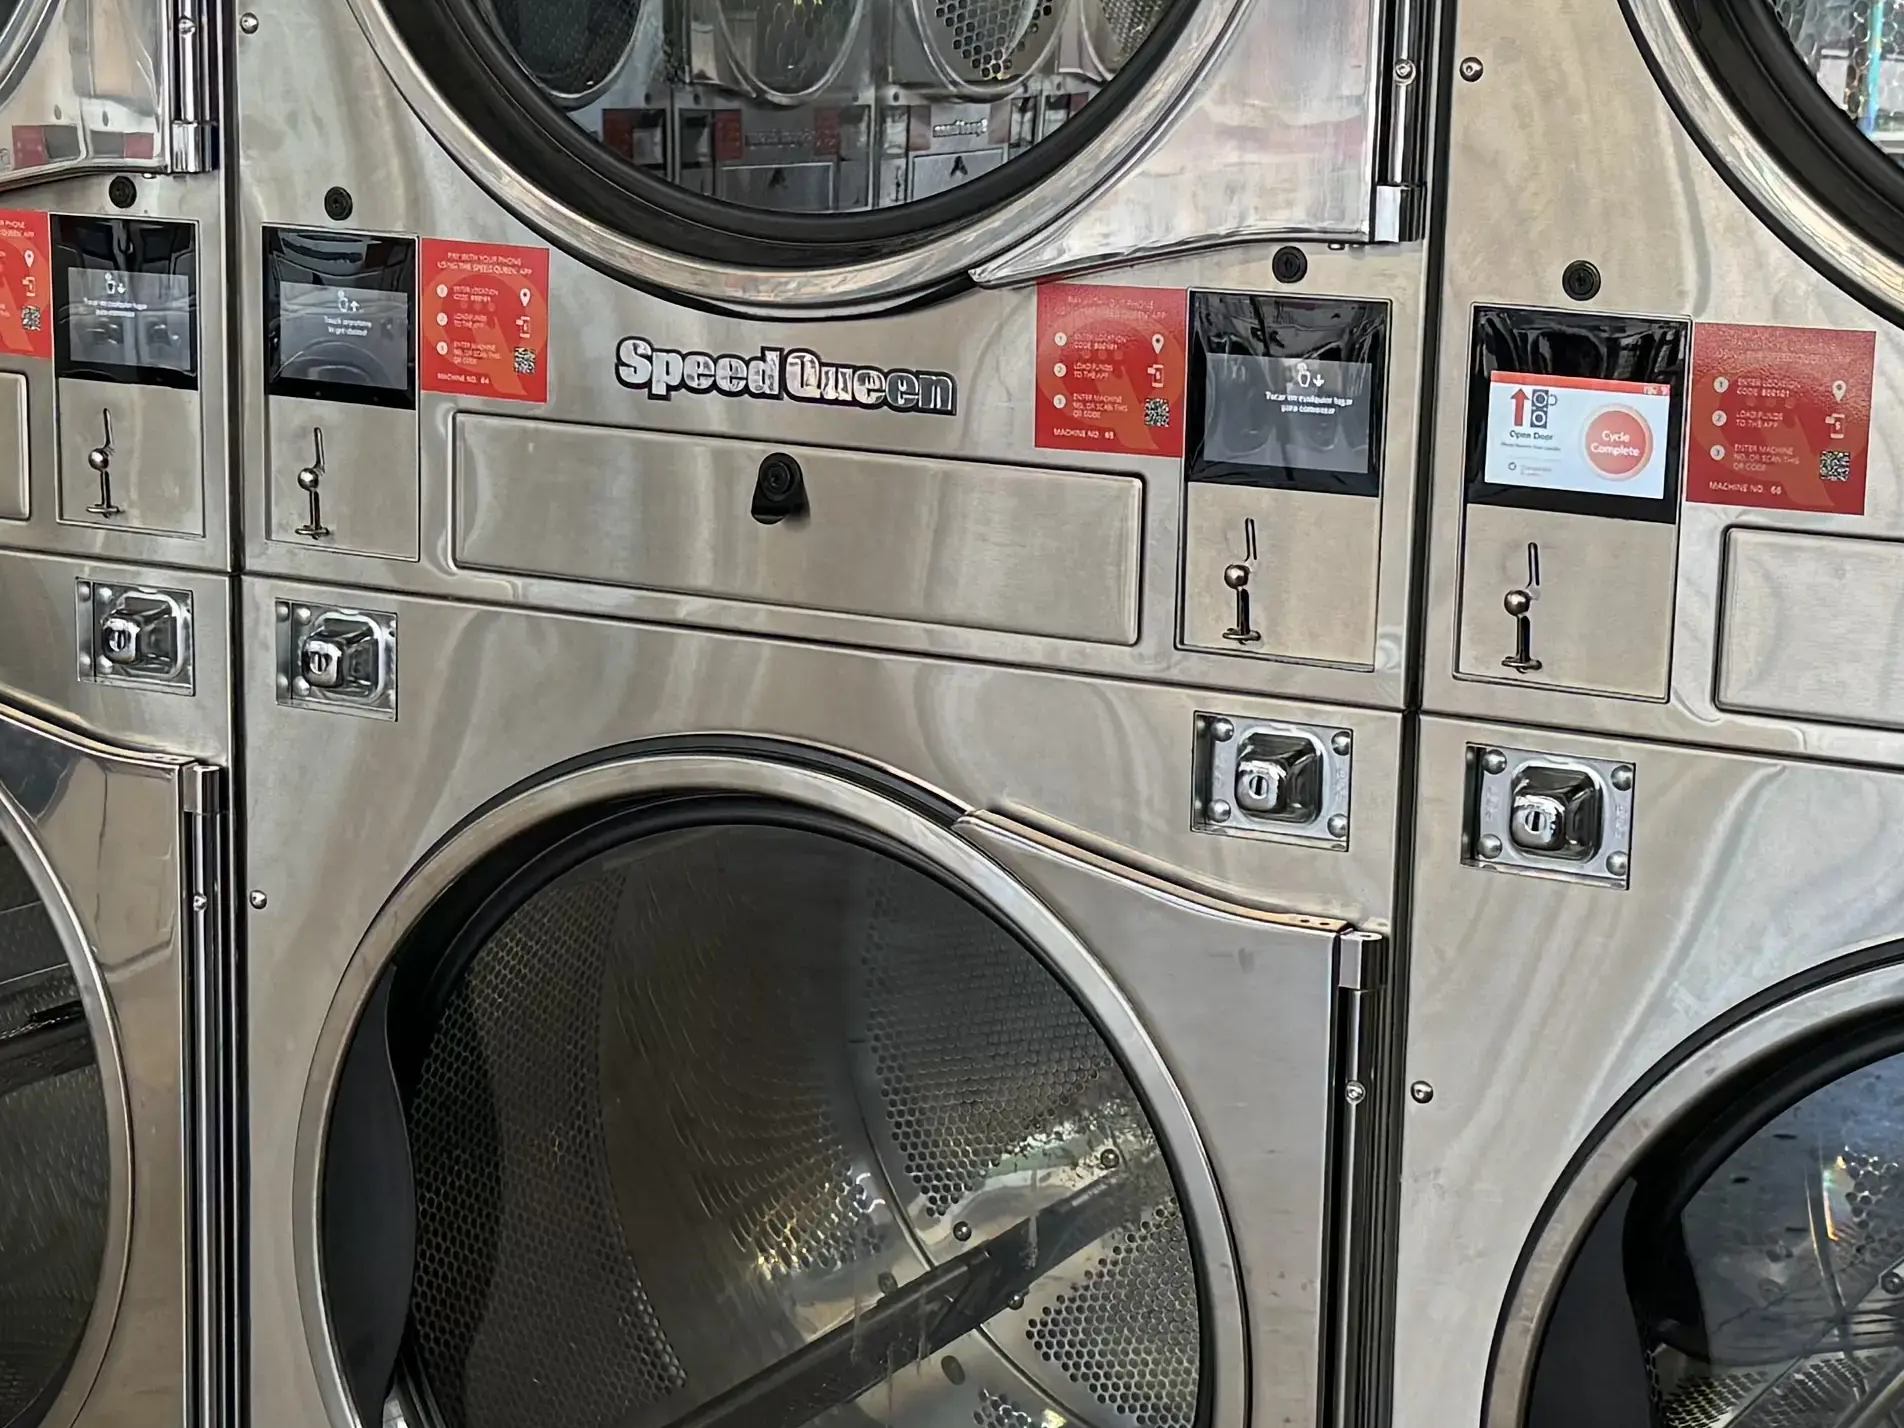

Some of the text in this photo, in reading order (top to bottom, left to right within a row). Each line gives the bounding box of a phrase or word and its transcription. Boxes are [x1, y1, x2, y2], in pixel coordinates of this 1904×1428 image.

[1509, 429, 1553, 441] Open Door
[1602, 430, 1630, 442] Cycle
[1590, 442, 1640, 457] Complete
[1709, 481, 1747, 492] MACHINE
